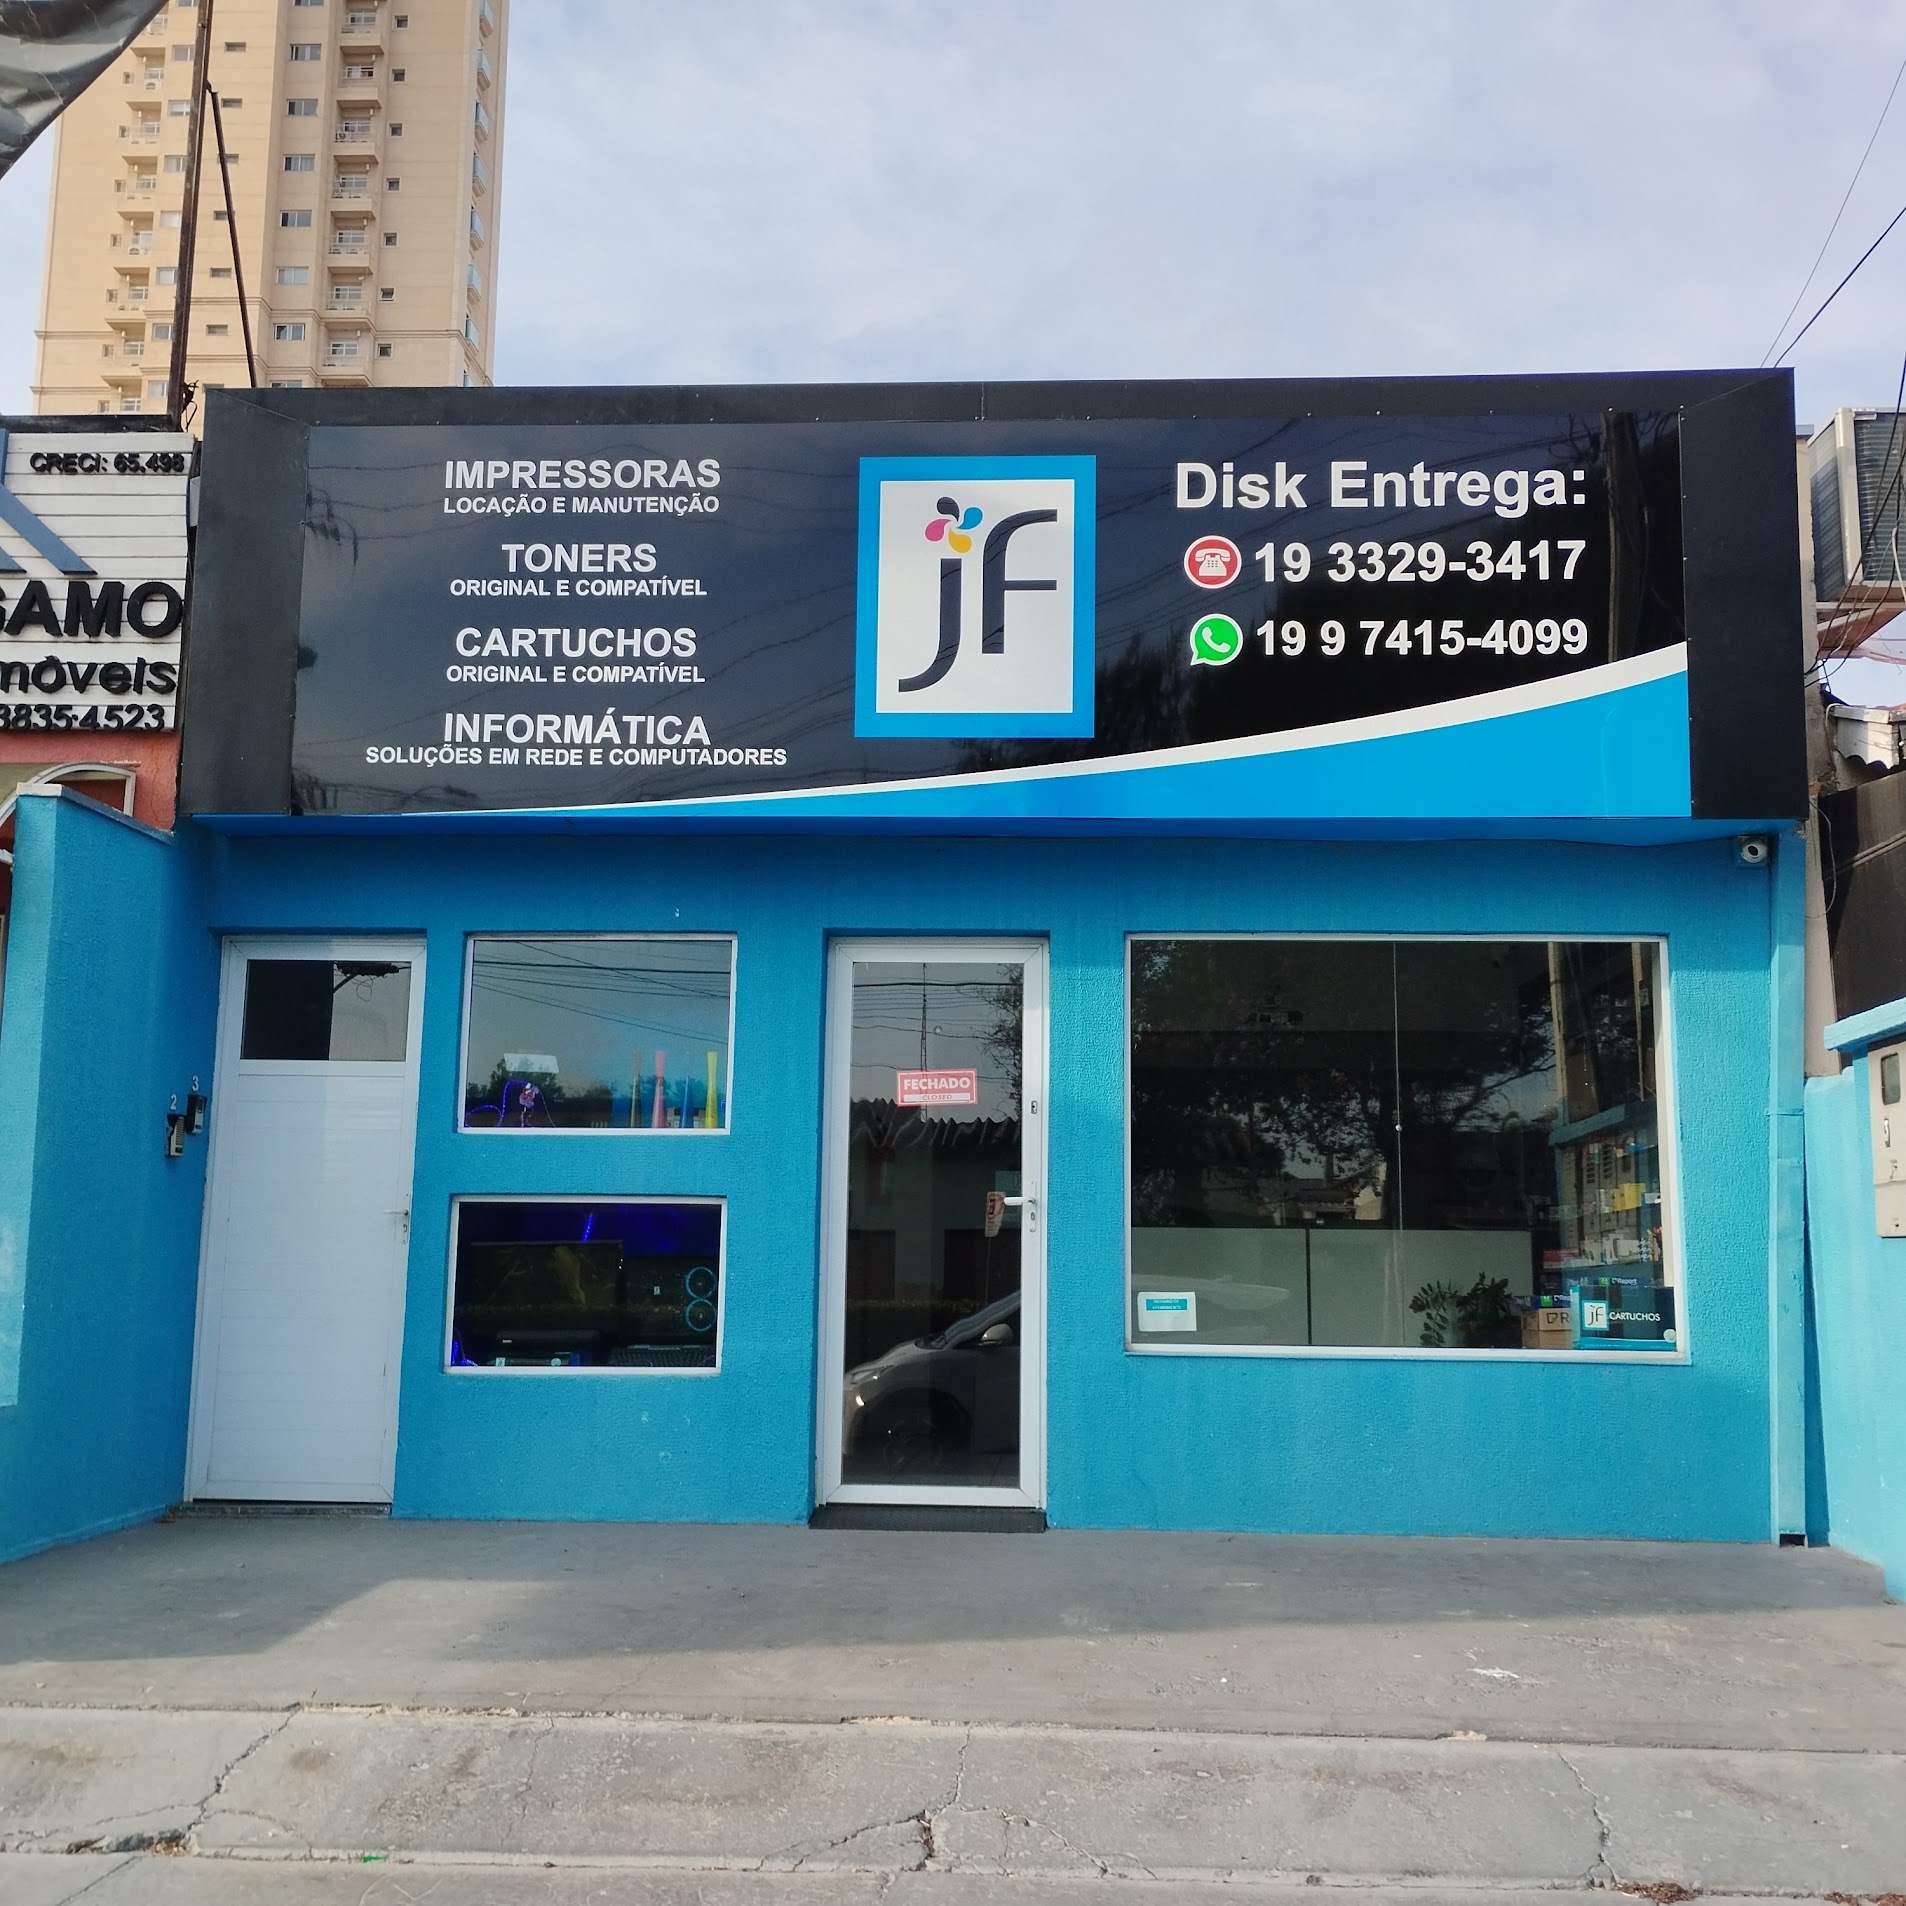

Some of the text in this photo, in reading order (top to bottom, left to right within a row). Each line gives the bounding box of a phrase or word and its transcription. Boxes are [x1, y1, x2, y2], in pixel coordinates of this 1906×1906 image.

[30, 452, 185, 473] CRECI: 65.498
[445, 458, 721, 489] IMPRESSORAS
[1176, 461, 1586, 519] Disk Entrega:
[443, 492, 720, 517] LOCAÇÃO E MANUTENÇÃO
[501, 543, 657, 573] TONERS
[1255, 540, 1586, 583] 19 3329-3417
[450, 575, 708, 597] ORIGINAL E COMPATÍVEL
[0, 580, 183, 638] AMO
[455, 627, 697, 658] CARTUCHOS
[1256, 618, 1588, 656] 19 9 7415-4099
[446, 661, 706, 683] ORIGINAL E COMPATÍVEL
[443, 707, 711, 746] INFORMÁTICA
[365, 745, 788, 768] SOLUÇÕES EM REDE E COMPUTADORES
[192, 1075, 199, 1092] 3
[903, 1077, 971, 1091] FECHADO
[170, 1093, 177, 1111] 2
[1608, 1311, 1661, 1322] CARTUCHOS
